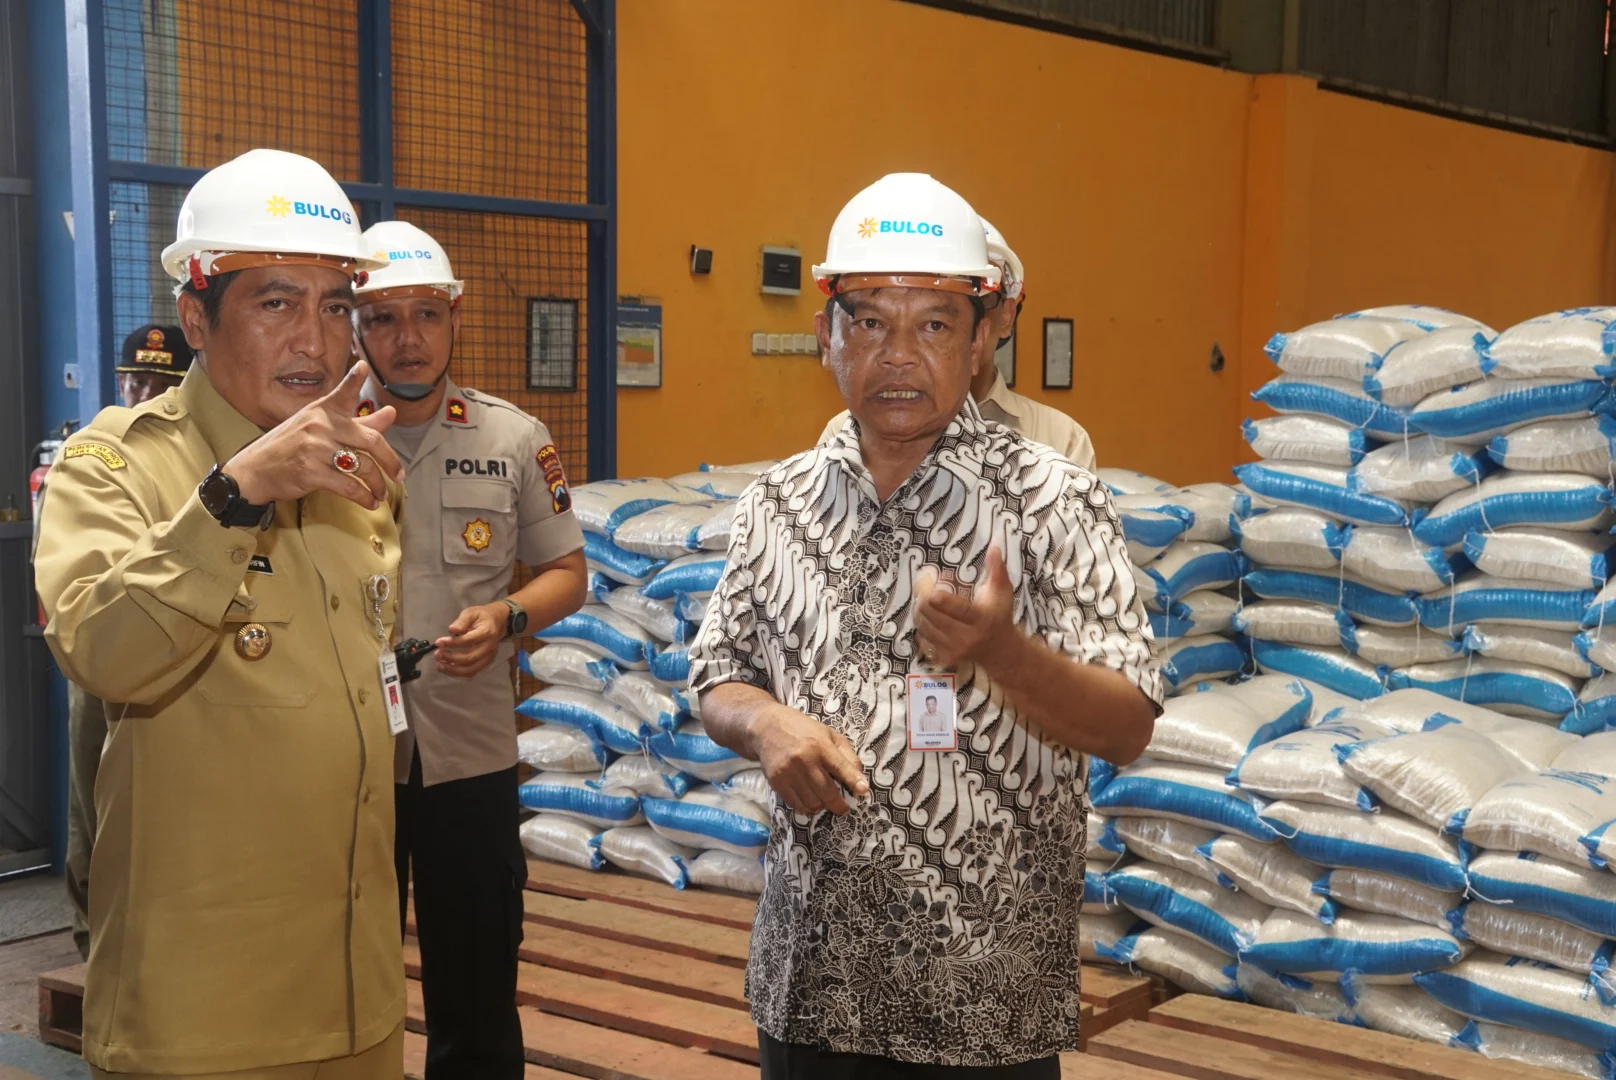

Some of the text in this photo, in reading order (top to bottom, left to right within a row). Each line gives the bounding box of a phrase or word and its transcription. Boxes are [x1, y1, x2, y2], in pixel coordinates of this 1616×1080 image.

[294, 201, 352, 225] BULOG
[880, 220, 944, 237] BULOG
[389, 250, 432, 261] BULOG
[445, 458, 507, 477] POLRI
